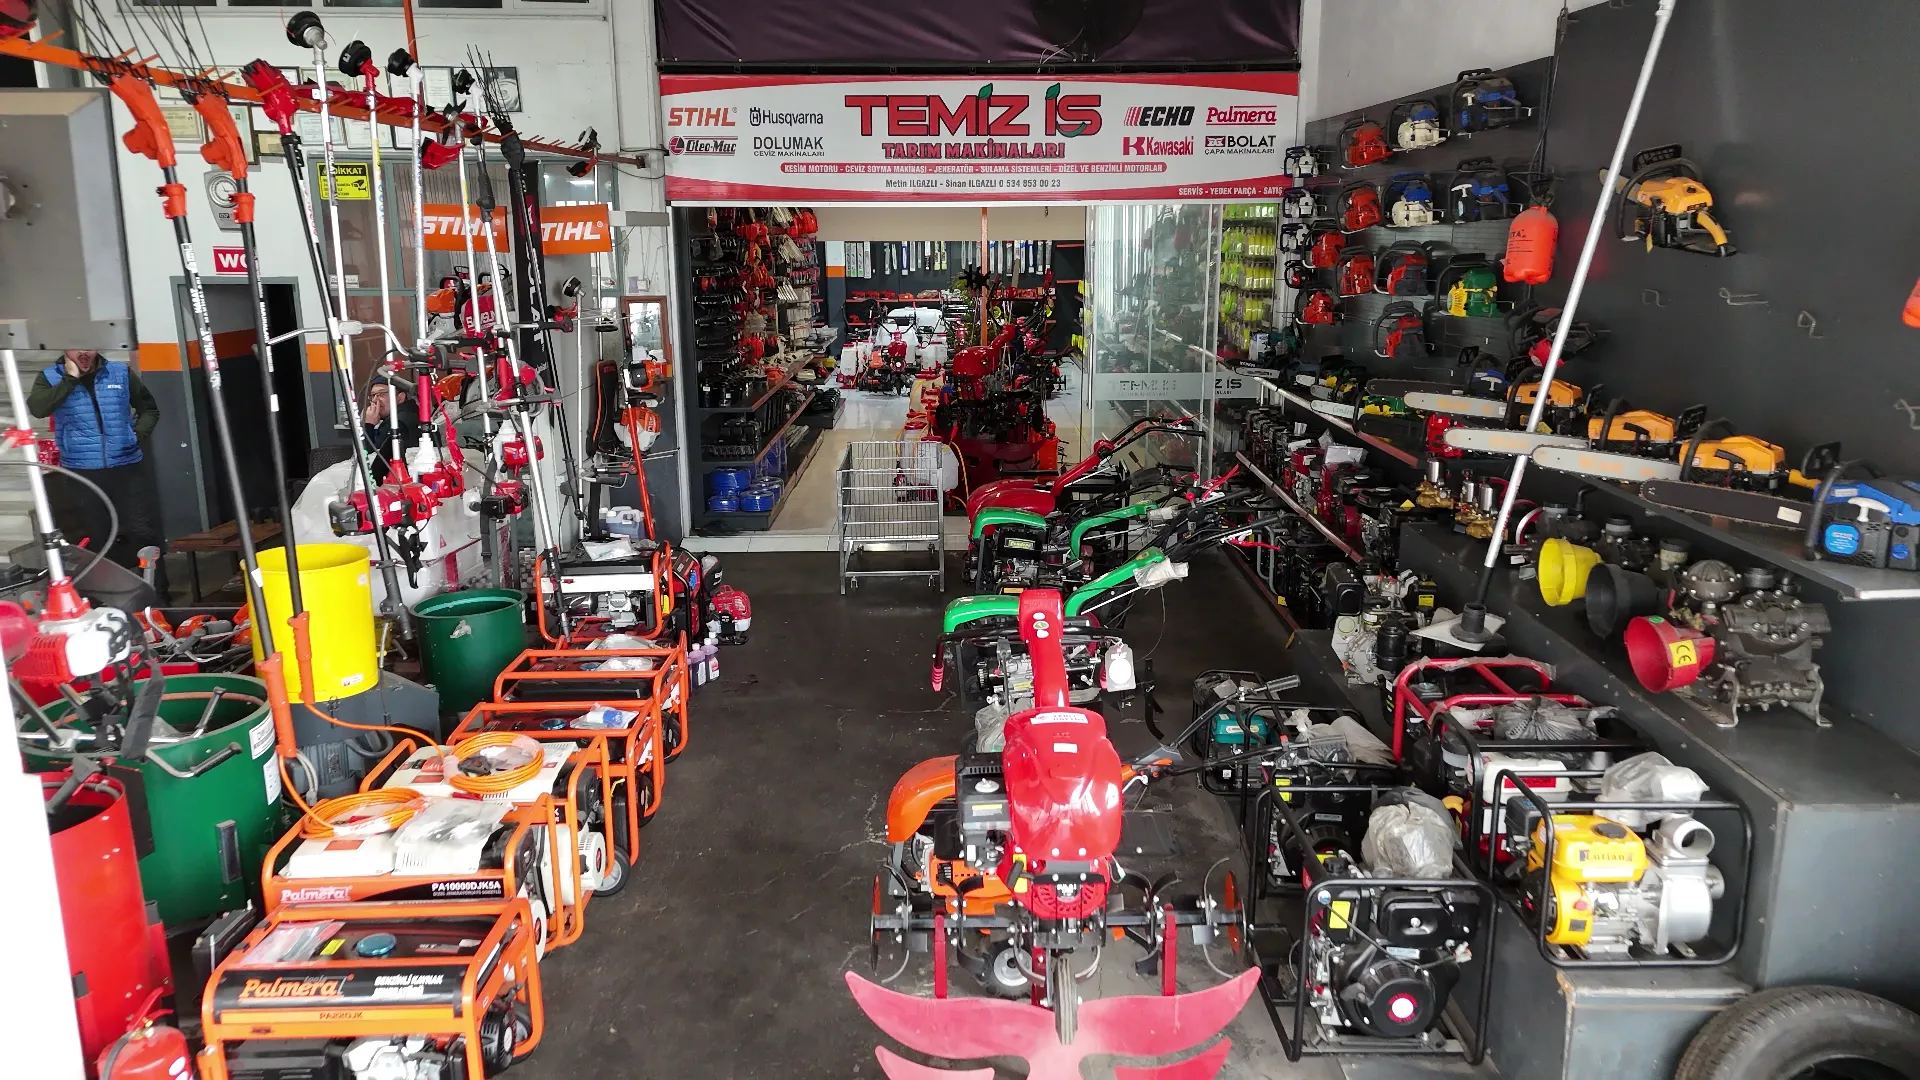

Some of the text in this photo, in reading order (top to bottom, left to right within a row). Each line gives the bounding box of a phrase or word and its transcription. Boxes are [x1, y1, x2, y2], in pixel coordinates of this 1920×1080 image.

[668, 108, 736, 127] STIHL
[763, 110, 824, 127] Husqvarna
[1139, 106, 1195, 126] ECHO
[1206, 107, 1277, 124] Palmera
[753, 137, 823, 150] DOLUMAK
[882, 138, 1065, 159] TARIM MAKİNALARI
[1146, 136, 1194, 156] Kawasaki
[1227, 135, 1276, 148] BOLAT
[809, 164, 838, 173] MOTORU
[867, 164, 892, 173] SOYMA
[980, 164, 1009, 173] SULAMA
[1080, 164, 1089, 173] VE
[1124, 164, 1163, 173] MOTORLAR
[885, 180, 907, 188] Metin
[945, 180, 967, 188] Sinan
[999, 180, 1004, 188] 0
[1006, 180, 1021, 188] 534
[1023, 180, 1037, 188] 853
[1039, 180, 1049, 188] 00
[1051, 180, 1061, 188] 23
[1178, 185, 1203, 195] SERVİS
[1210, 186, 1232, 195] YEDEK
[1234, 186, 1257, 196] PARÇA
[1263, 186, 1284, 196] SATIŞ
[542, 221, 601, 242] TIHL
[281, 885, 347, 901] Palmera
[239, 978, 339, 999] Palmera
